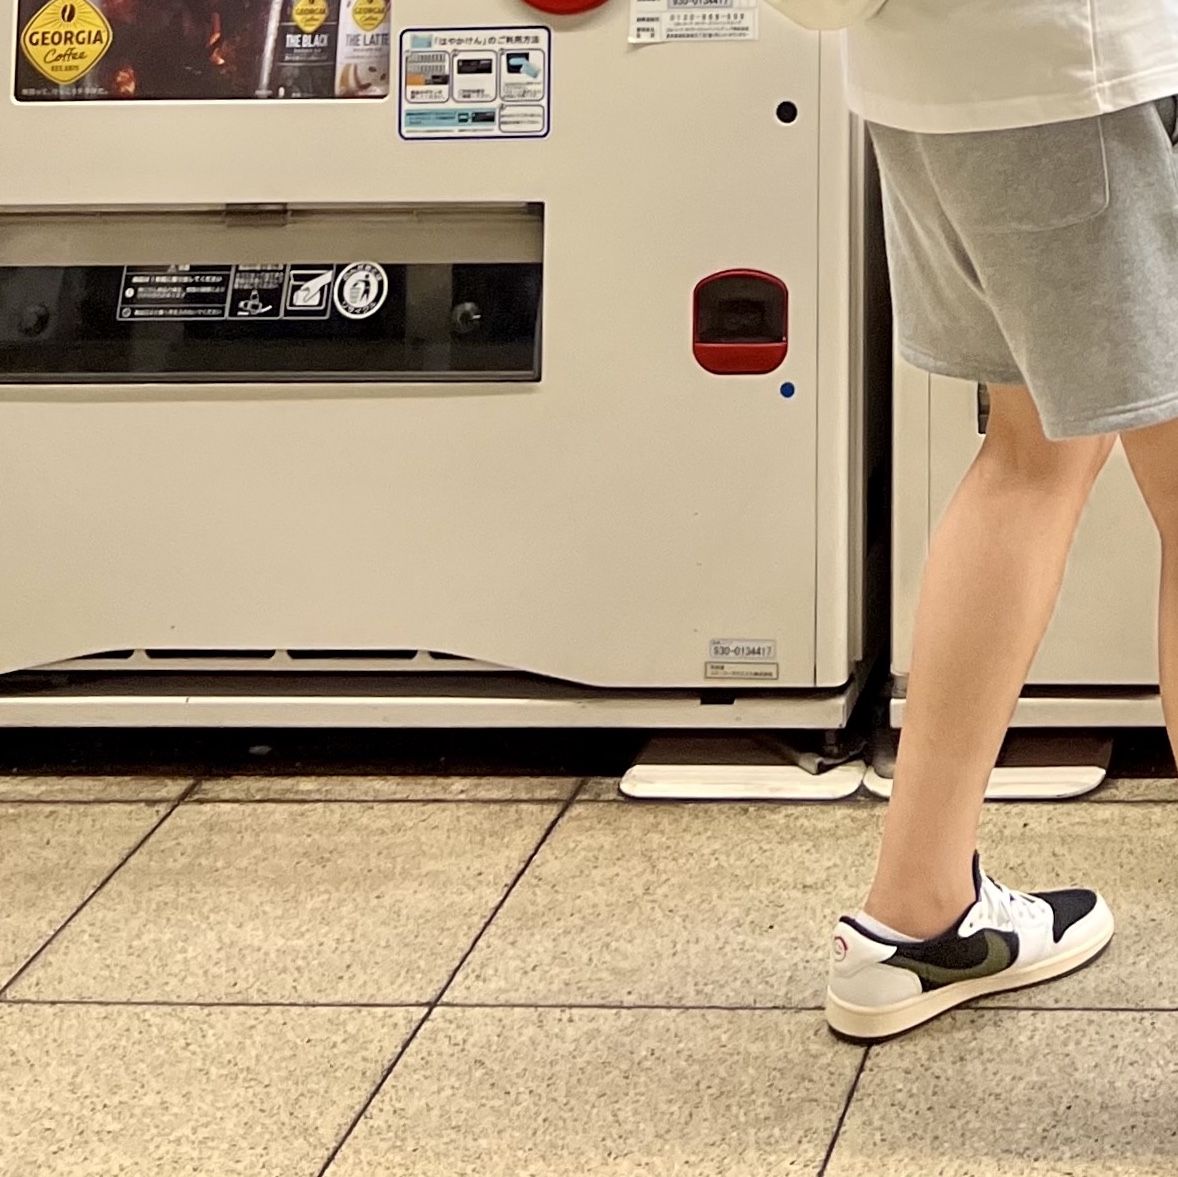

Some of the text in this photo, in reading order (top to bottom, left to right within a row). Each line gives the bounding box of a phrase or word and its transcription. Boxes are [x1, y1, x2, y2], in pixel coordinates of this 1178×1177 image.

[29, 29, 103, 48] GEORGIA
[286, 33, 329, 47] THE BLACK
[345, 33, 390, 47] THE LATTE
[43, 47, 88, 65] Coffee
